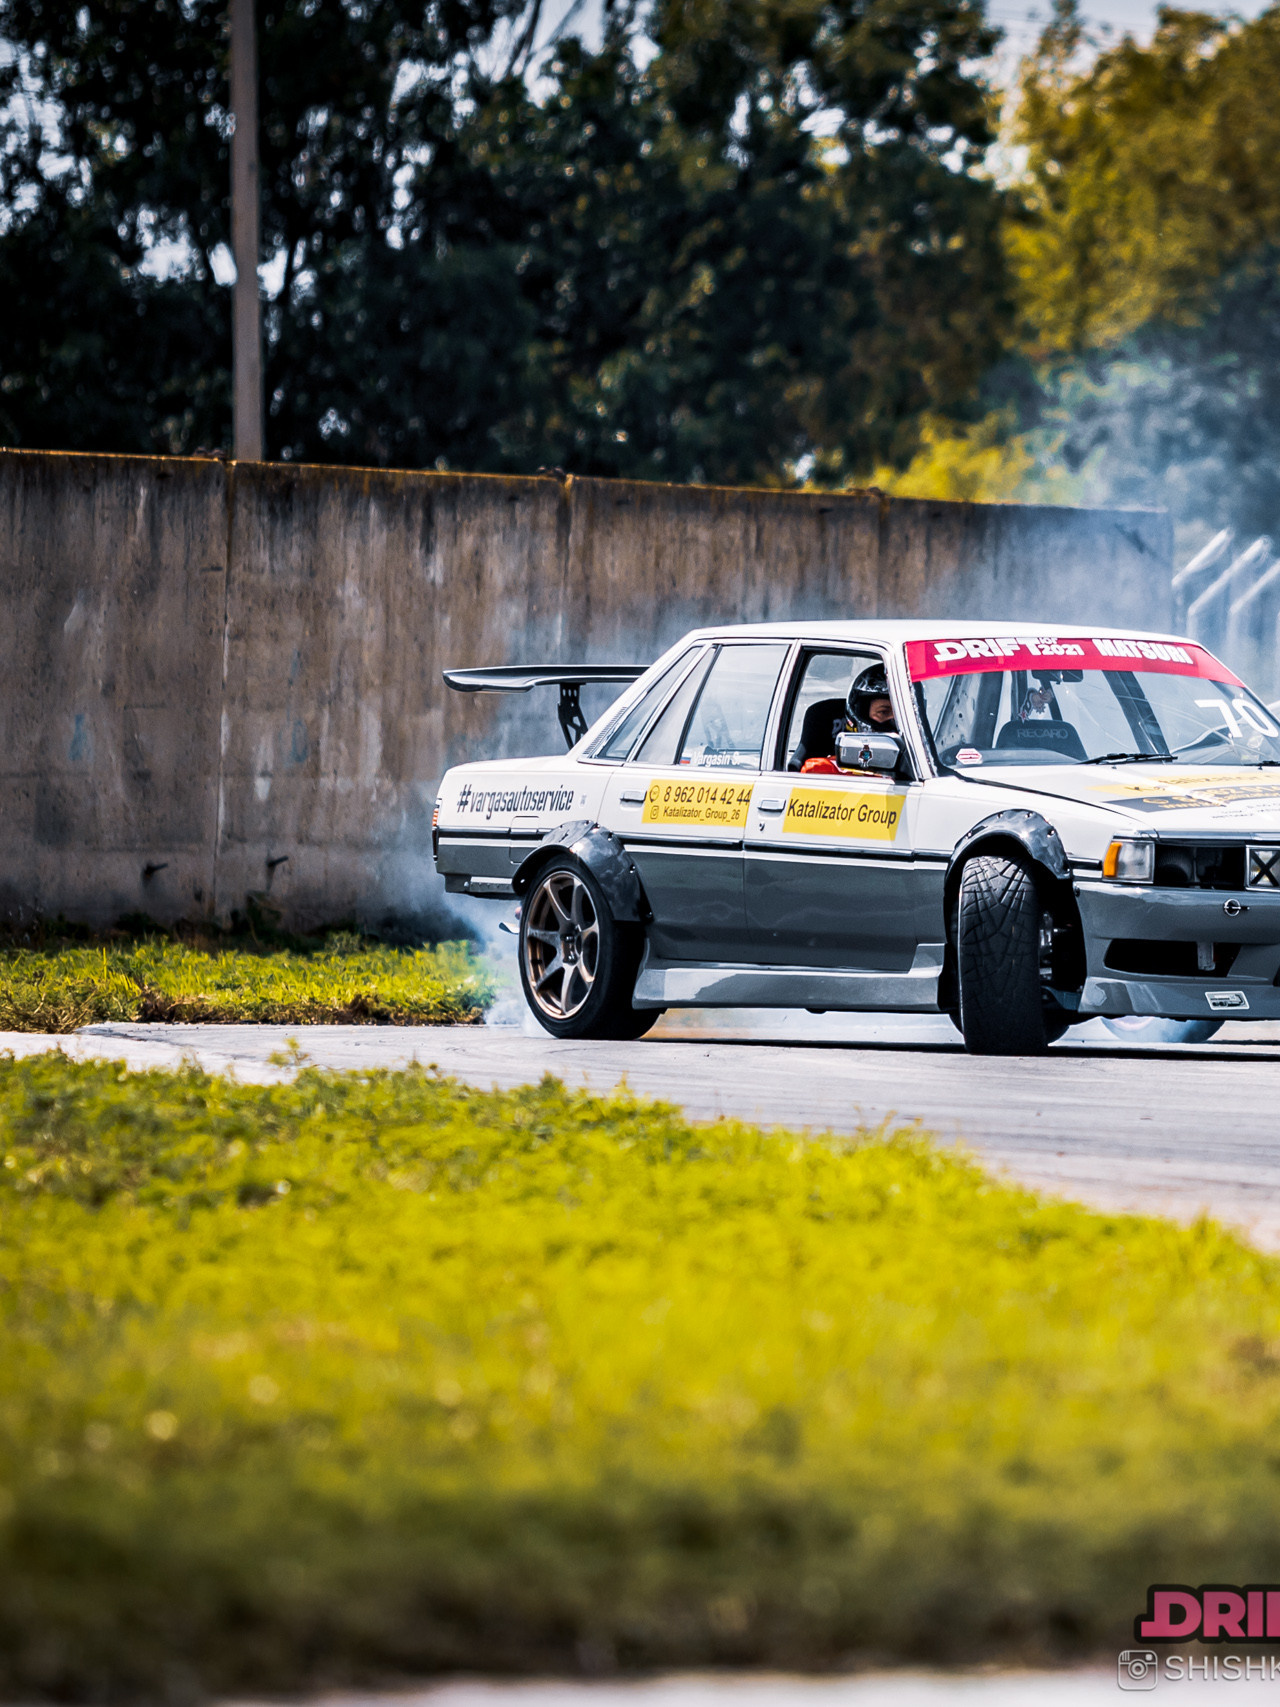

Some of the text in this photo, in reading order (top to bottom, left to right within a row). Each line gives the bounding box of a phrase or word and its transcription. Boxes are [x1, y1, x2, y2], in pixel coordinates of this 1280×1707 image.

[933, 637, 1042, 662] DRIFT
[1038, 644, 1085, 656] 2021
[1091, 638, 1194, 665] MATSURI
[1194, 699, 1279, 738] 70
[1017, 728, 1069, 739] RECARO
[457, 784, 575, 820] #vargasautoservice
[663, 785, 752, 806] 8 962 014 42 44
[663, 805, 741, 823] Katalizator_Group_26
[787, 798, 897, 829] Katalizator Group
